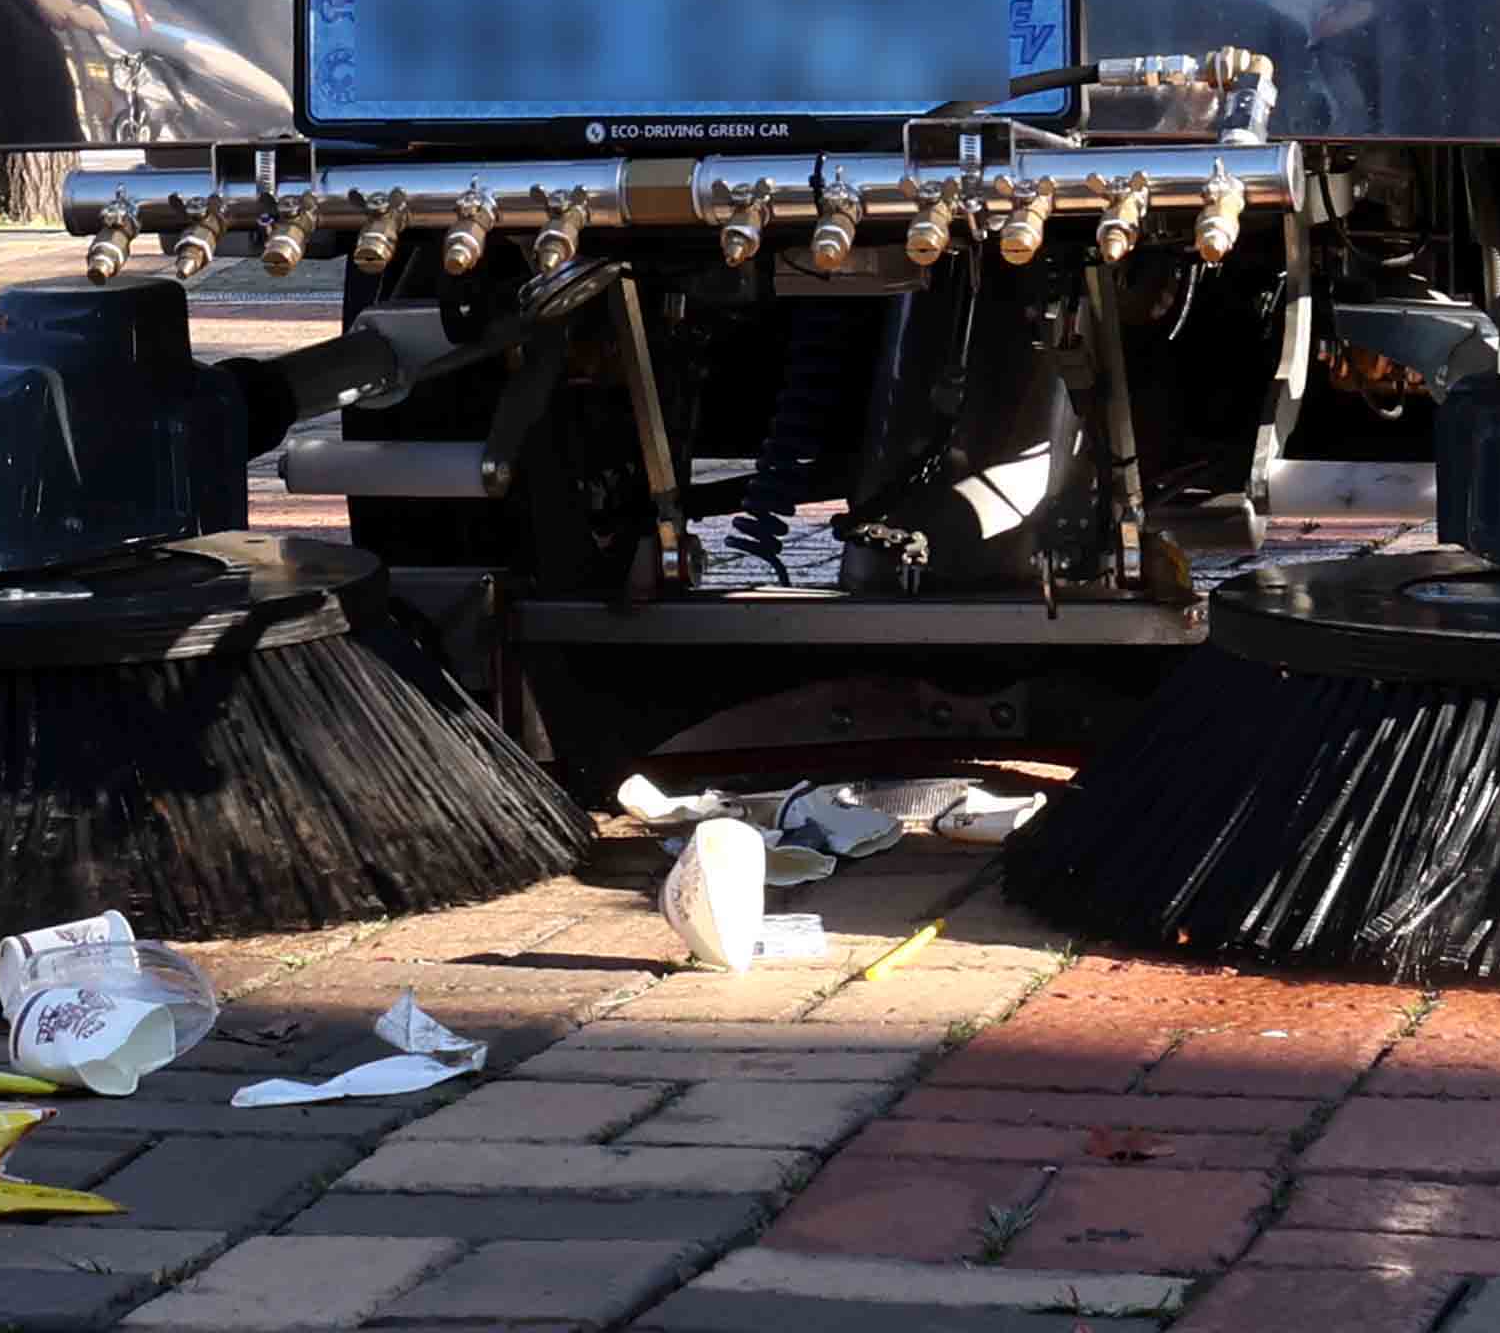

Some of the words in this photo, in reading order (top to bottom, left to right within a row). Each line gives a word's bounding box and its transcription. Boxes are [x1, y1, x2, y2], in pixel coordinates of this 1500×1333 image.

[610, 123, 705, 139] ECO-DRIVING
[707, 123, 756, 138] GREEN
[758, 123, 790, 138] CAR
